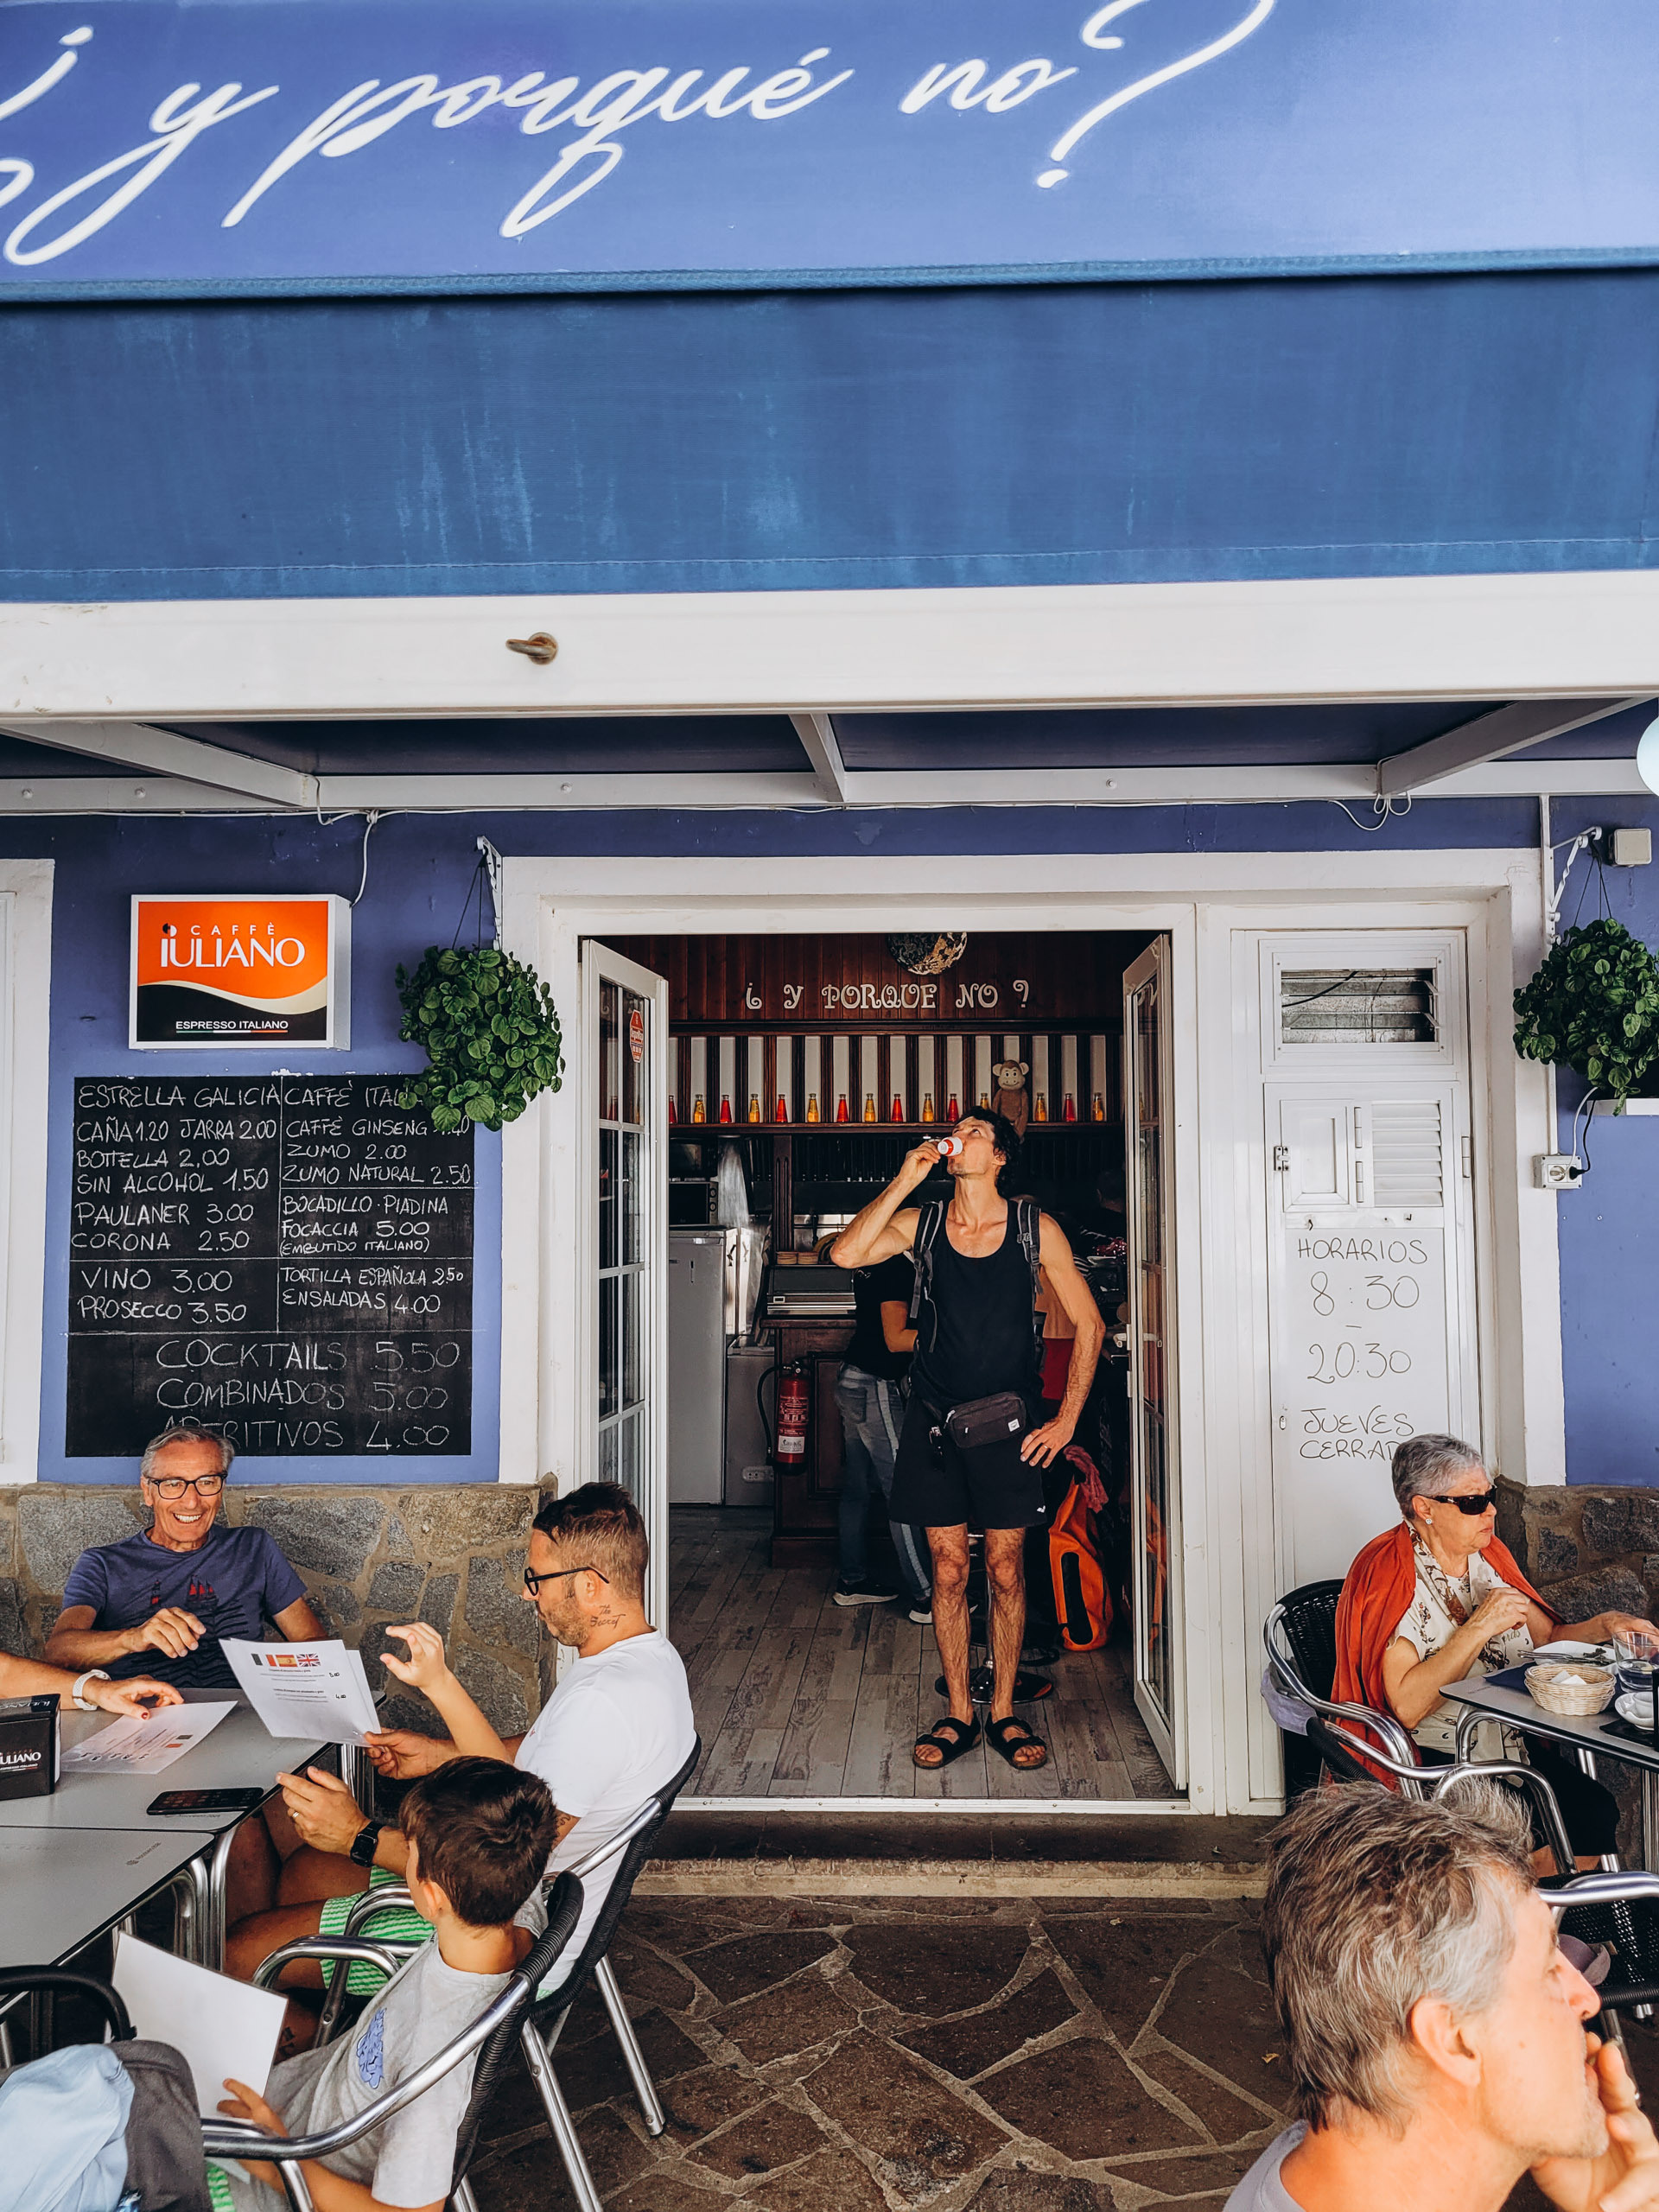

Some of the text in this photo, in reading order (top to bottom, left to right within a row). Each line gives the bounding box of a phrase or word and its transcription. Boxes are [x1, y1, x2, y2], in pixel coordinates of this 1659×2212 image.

[221, 46, 854, 239] porqué
[191, 922, 275, 936] CAFFÈ
[822, 983, 938, 1009] PORQUE
[956, 983, 998, 1008] NO
[175, 1020, 289, 1030] ESPRESSO ITALIANO
[79, 1084, 281, 1108] ESTRELLA GALICIA
[76, 1116, 276, 1142] CAÑA 1.20 JARRA 2.00
[352, 1119, 428, 1135] GINSENG
[179, 1148, 230, 1168] 2.00
[287, 1143, 407, 1160] ZUMO 2.00
[77, 1168, 269, 1194] SIN ALCOHOL 1.50
[282, 1163, 471, 1185] ZUMO NATURAL 2.50
[75, 1203, 254, 1226] PAULANER 3.00
[283, 1195, 448, 1215] BOCADILLO PIADINA
[282, 1219, 429, 1238] FOCACCIA 5.00
[71, 1230, 251, 1252] CORONA 2.50
[365, 1237, 429, 1253] ITALIANO)
[1298, 1237, 1427, 1264] HORARIOS
[81, 1268, 232, 1294] VINO 3.00
[280, 1268, 351, 1284] TORTILLA
[359, 1266, 426, 1286] ESPAÑOLA
[77, 1295, 246, 1324] PROSECCO 3.50
[283, 1288, 441, 1313] ENSALADAS 4.00
[156, 1339, 346, 1370] COCKTAILS
[1307, 1342, 1411, 1383] 20:30
[156, 1378, 448, 1411] COMBINADOS 5.00
[1300, 1405, 1414, 1437] JUEVES
[366, 1421, 449, 1450] 4.00
